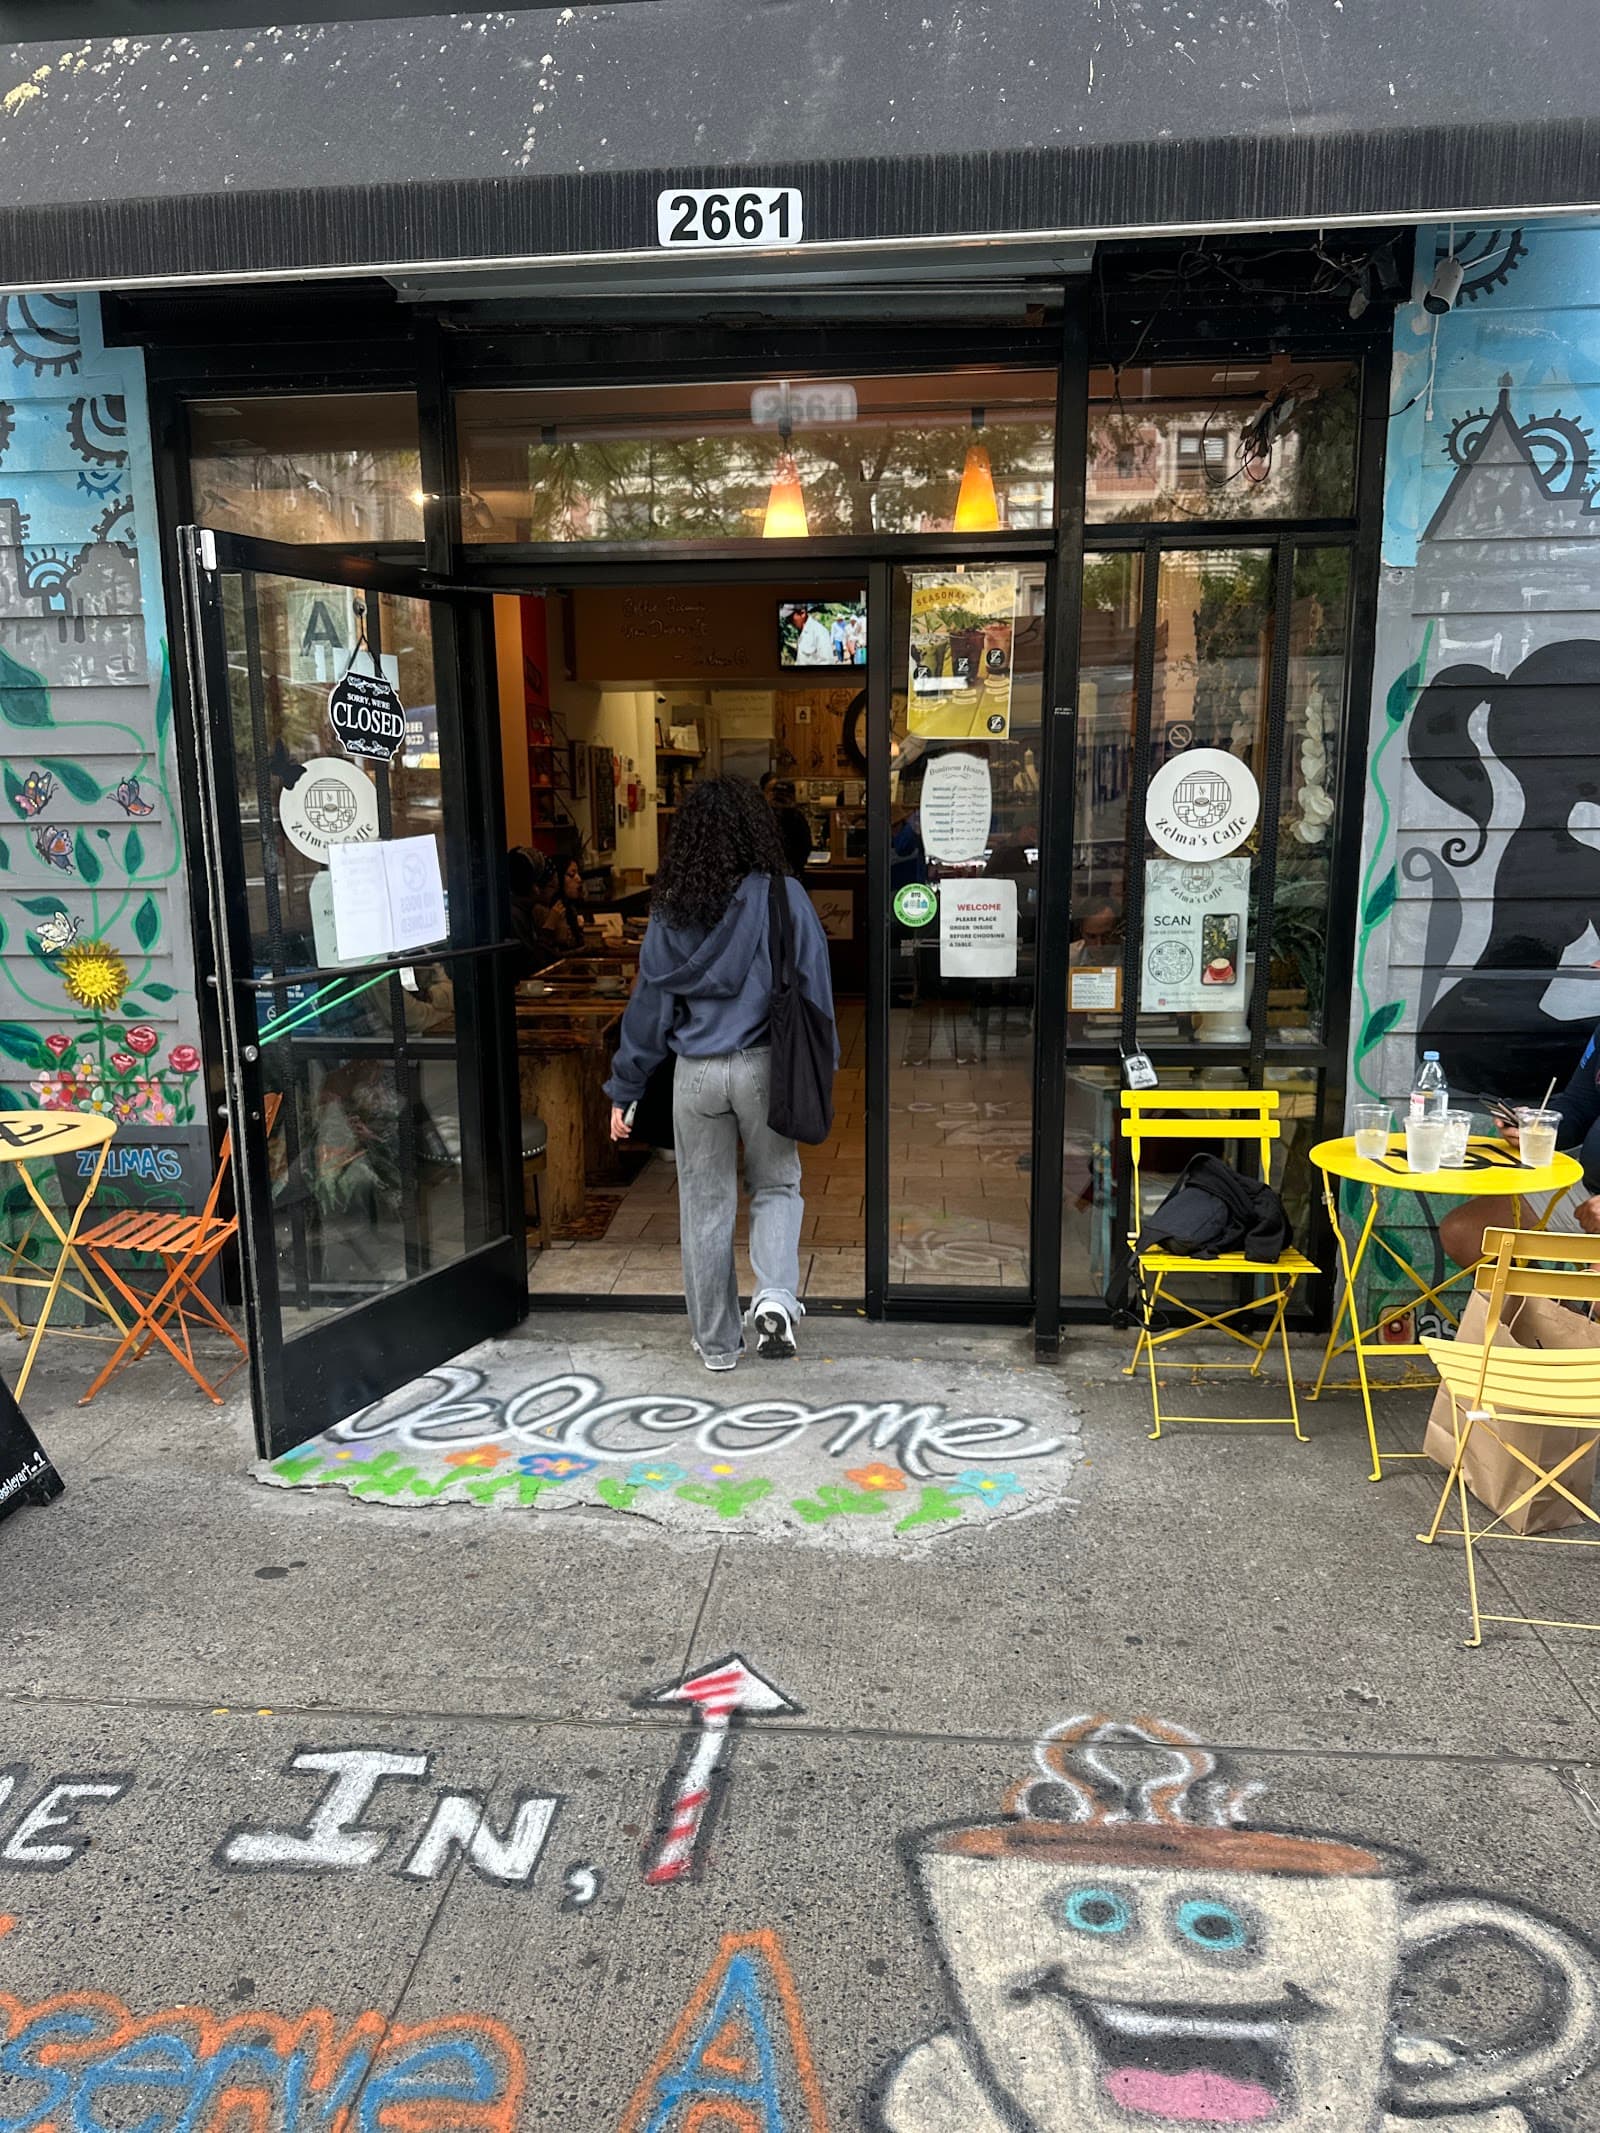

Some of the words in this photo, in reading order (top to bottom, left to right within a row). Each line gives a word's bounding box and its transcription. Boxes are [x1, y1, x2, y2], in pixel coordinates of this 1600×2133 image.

[669, 191, 790, 241] 2661
[347, 692, 371, 706] SORRY,
[333, 701, 404, 738] CLOSED
[1155, 816, 1208, 847] Zelma's
[1212, 815, 1248, 845] Caffe
[957, 903, 1001, 911] WELCOME
[1170, 885, 1201, 904] Zelma's
[1203, 885, 1223, 904] Caffe
[1153, 915, 1191, 927] SCAN
[214, 1745, 601, 1908] IN,
[622, 1928, 826, 2133] A
